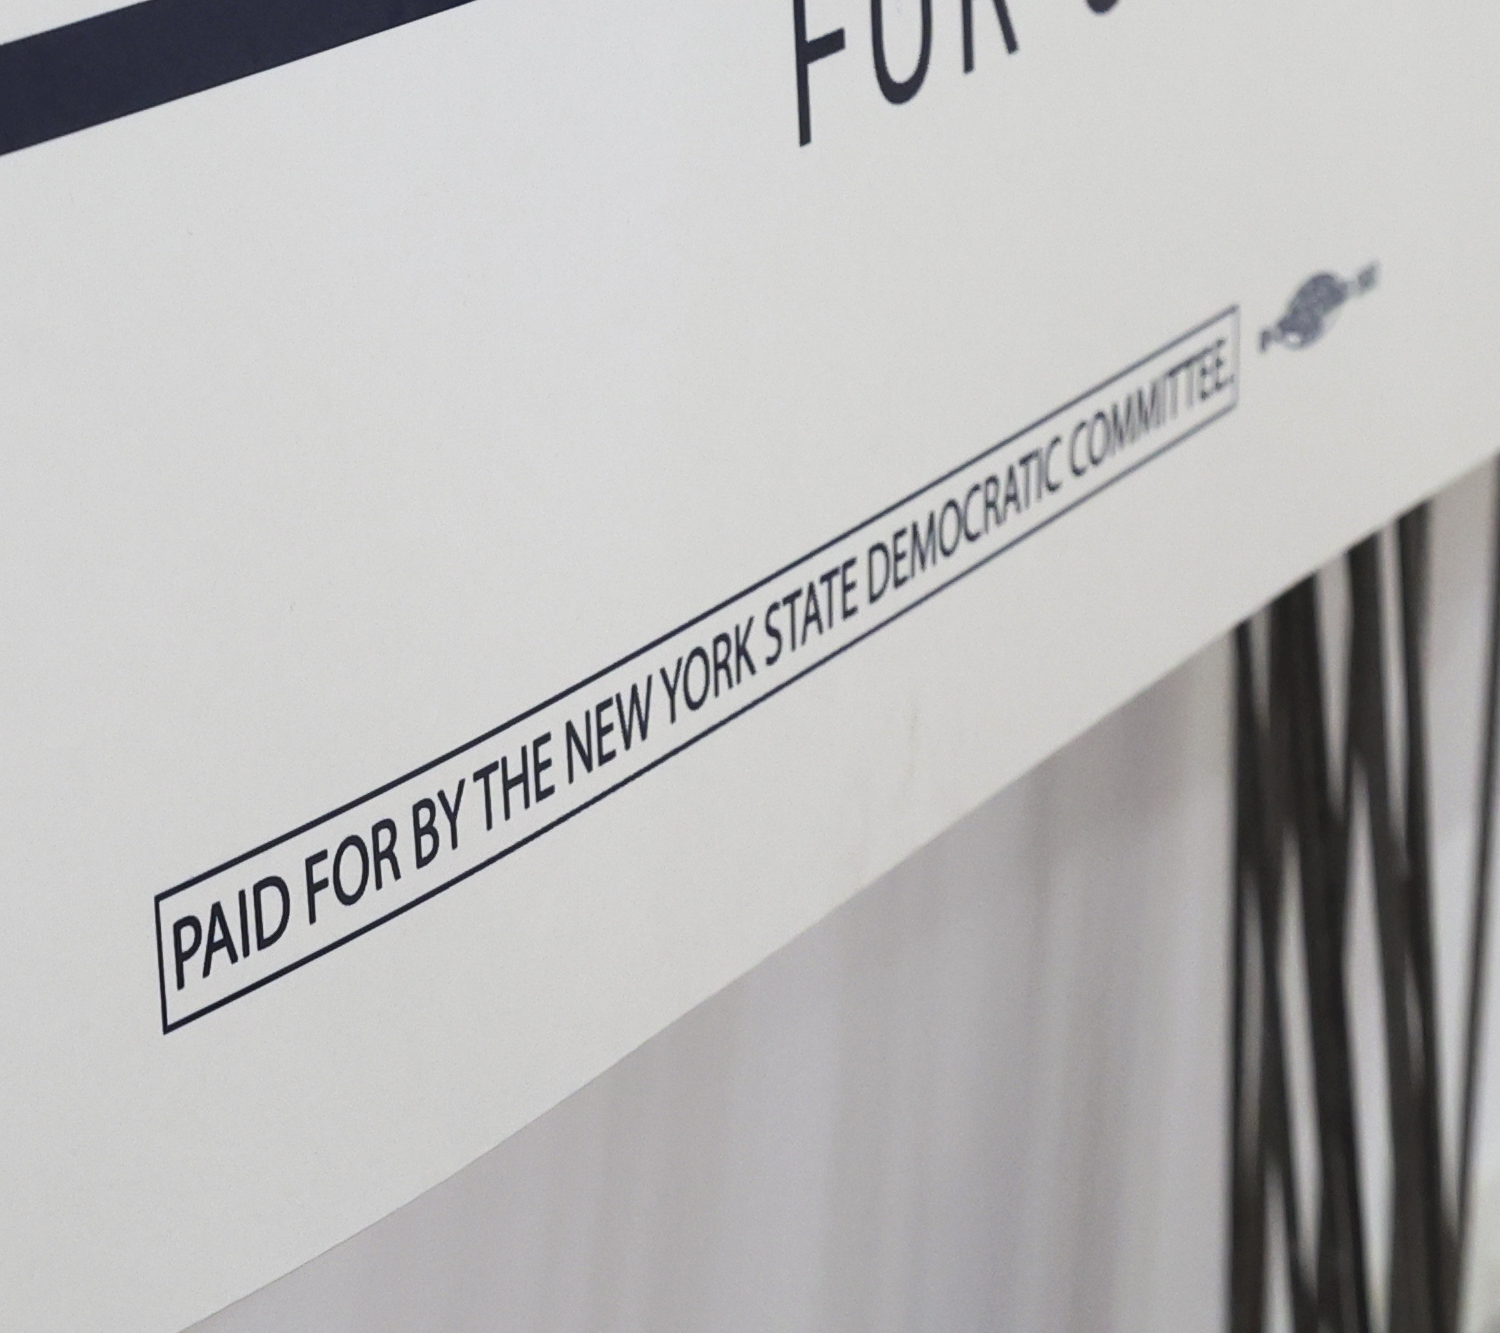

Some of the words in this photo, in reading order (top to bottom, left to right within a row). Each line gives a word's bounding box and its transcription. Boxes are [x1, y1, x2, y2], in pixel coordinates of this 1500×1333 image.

[172, 875, 291, 991] PAID
[304, 817, 402, 925] FOR
[411, 777, 466, 870] BY
[472, 731, 556, 831] THE
[565, 673, 653, 785] NEW
[659, 615, 757, 725] YORK
[764, 557, 858, 667] STATE
[867, 434, 1064, 605] DEMOCRATIC
